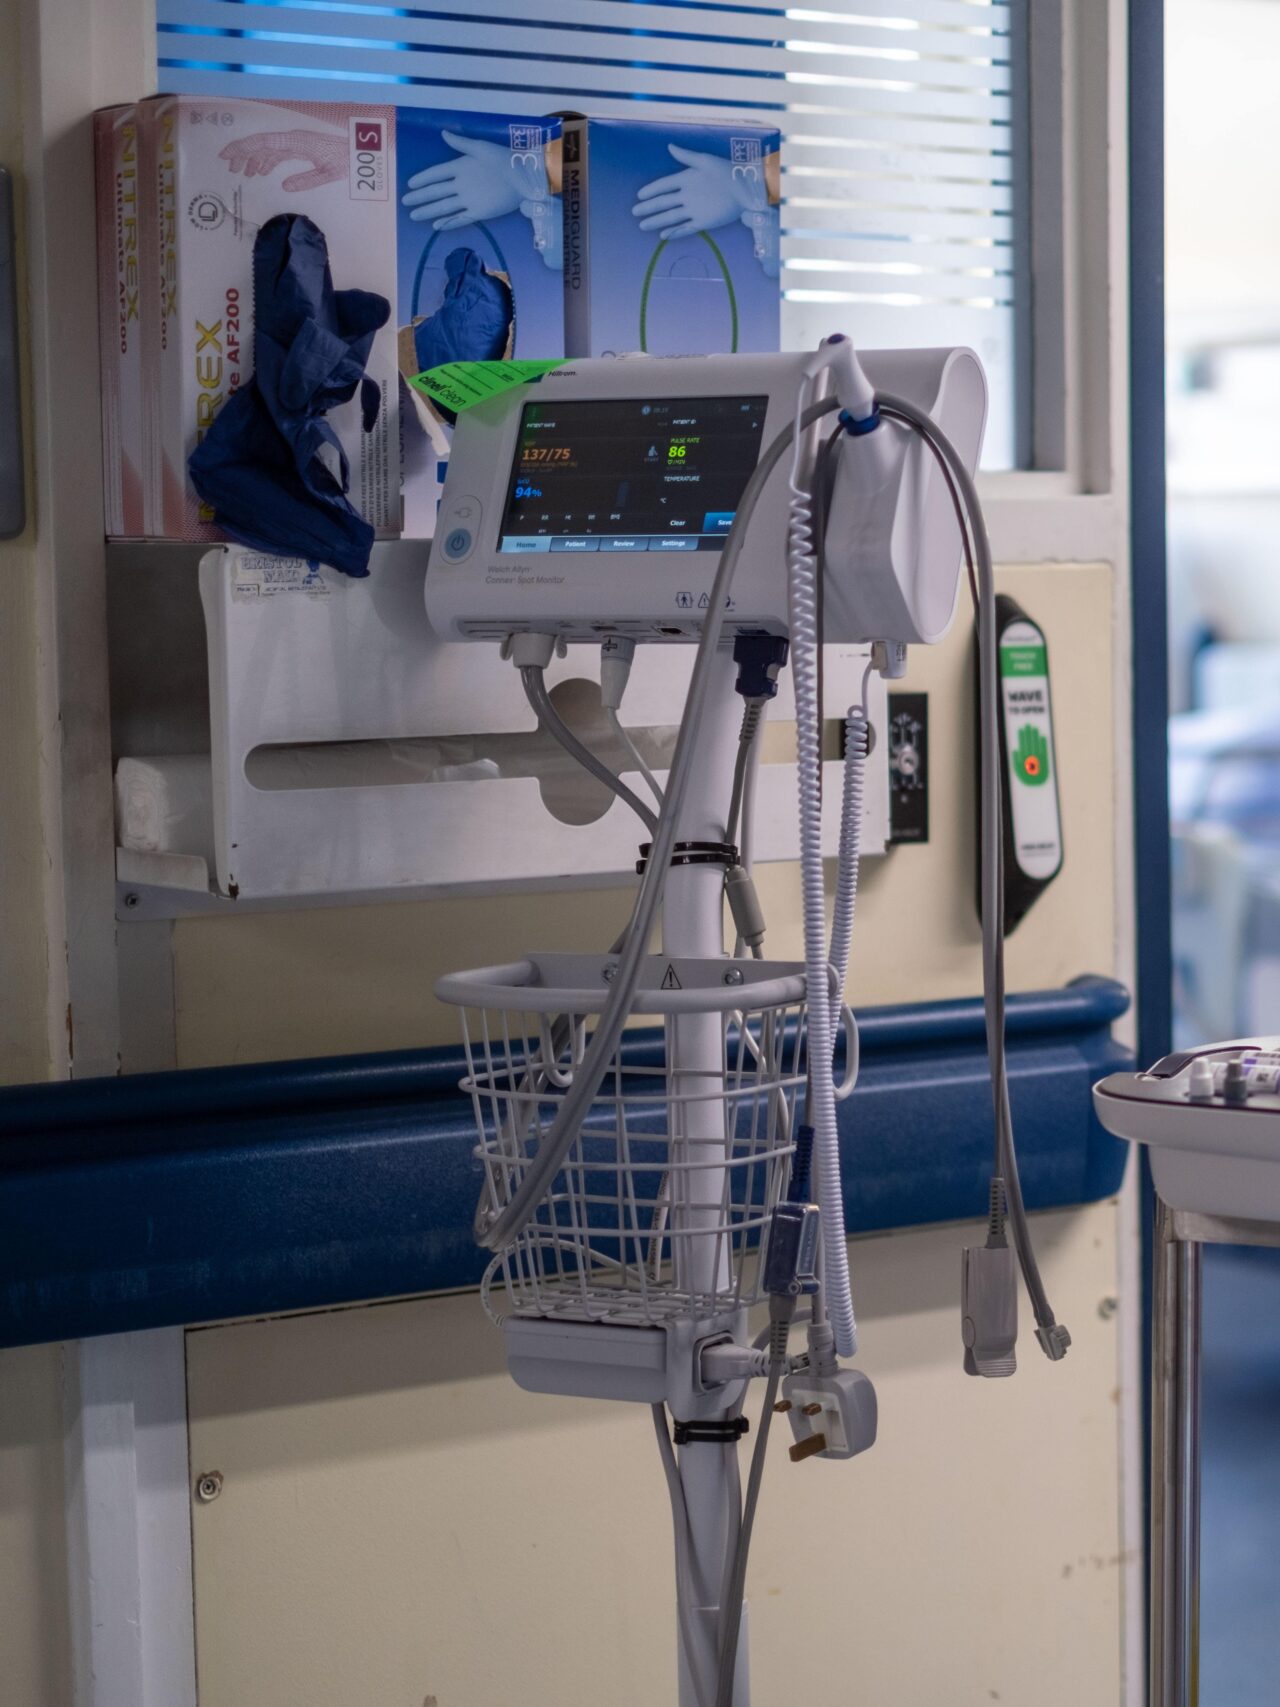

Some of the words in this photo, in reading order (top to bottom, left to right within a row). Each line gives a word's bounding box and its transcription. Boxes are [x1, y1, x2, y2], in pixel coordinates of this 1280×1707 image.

[359, 131, 378, 143] S
[510, 153, 538, 171] 3
[356, 152, 376, 192] 200
[732, 166, 758, 183] 3
[117, 172, 126, 272] Ultimate
[162, 117, 177, 317] NITREX
[123, 126, 138, 323] NITREX
[570, 170, 581, 290] MEDIGUARD
[119, 281, 127, 354] AF200
[225, 288, 239, 364] AF200
[522, 448, 571, 462] 137/75
[668, 446, 686, 457] 86
[515, 487, 542, 498] 94%
[661, 539, 686, 548] Settings
[241, 558, 302, 569] BRISTOL
[487, 565, 511, 573] Welch
[517, 575, 535, 585] Spot
[536, 575, 565, 584] Monitor
[1008, 690, 1042, 702] WAVE
[1022, 705, 1045, 714] OPEN
